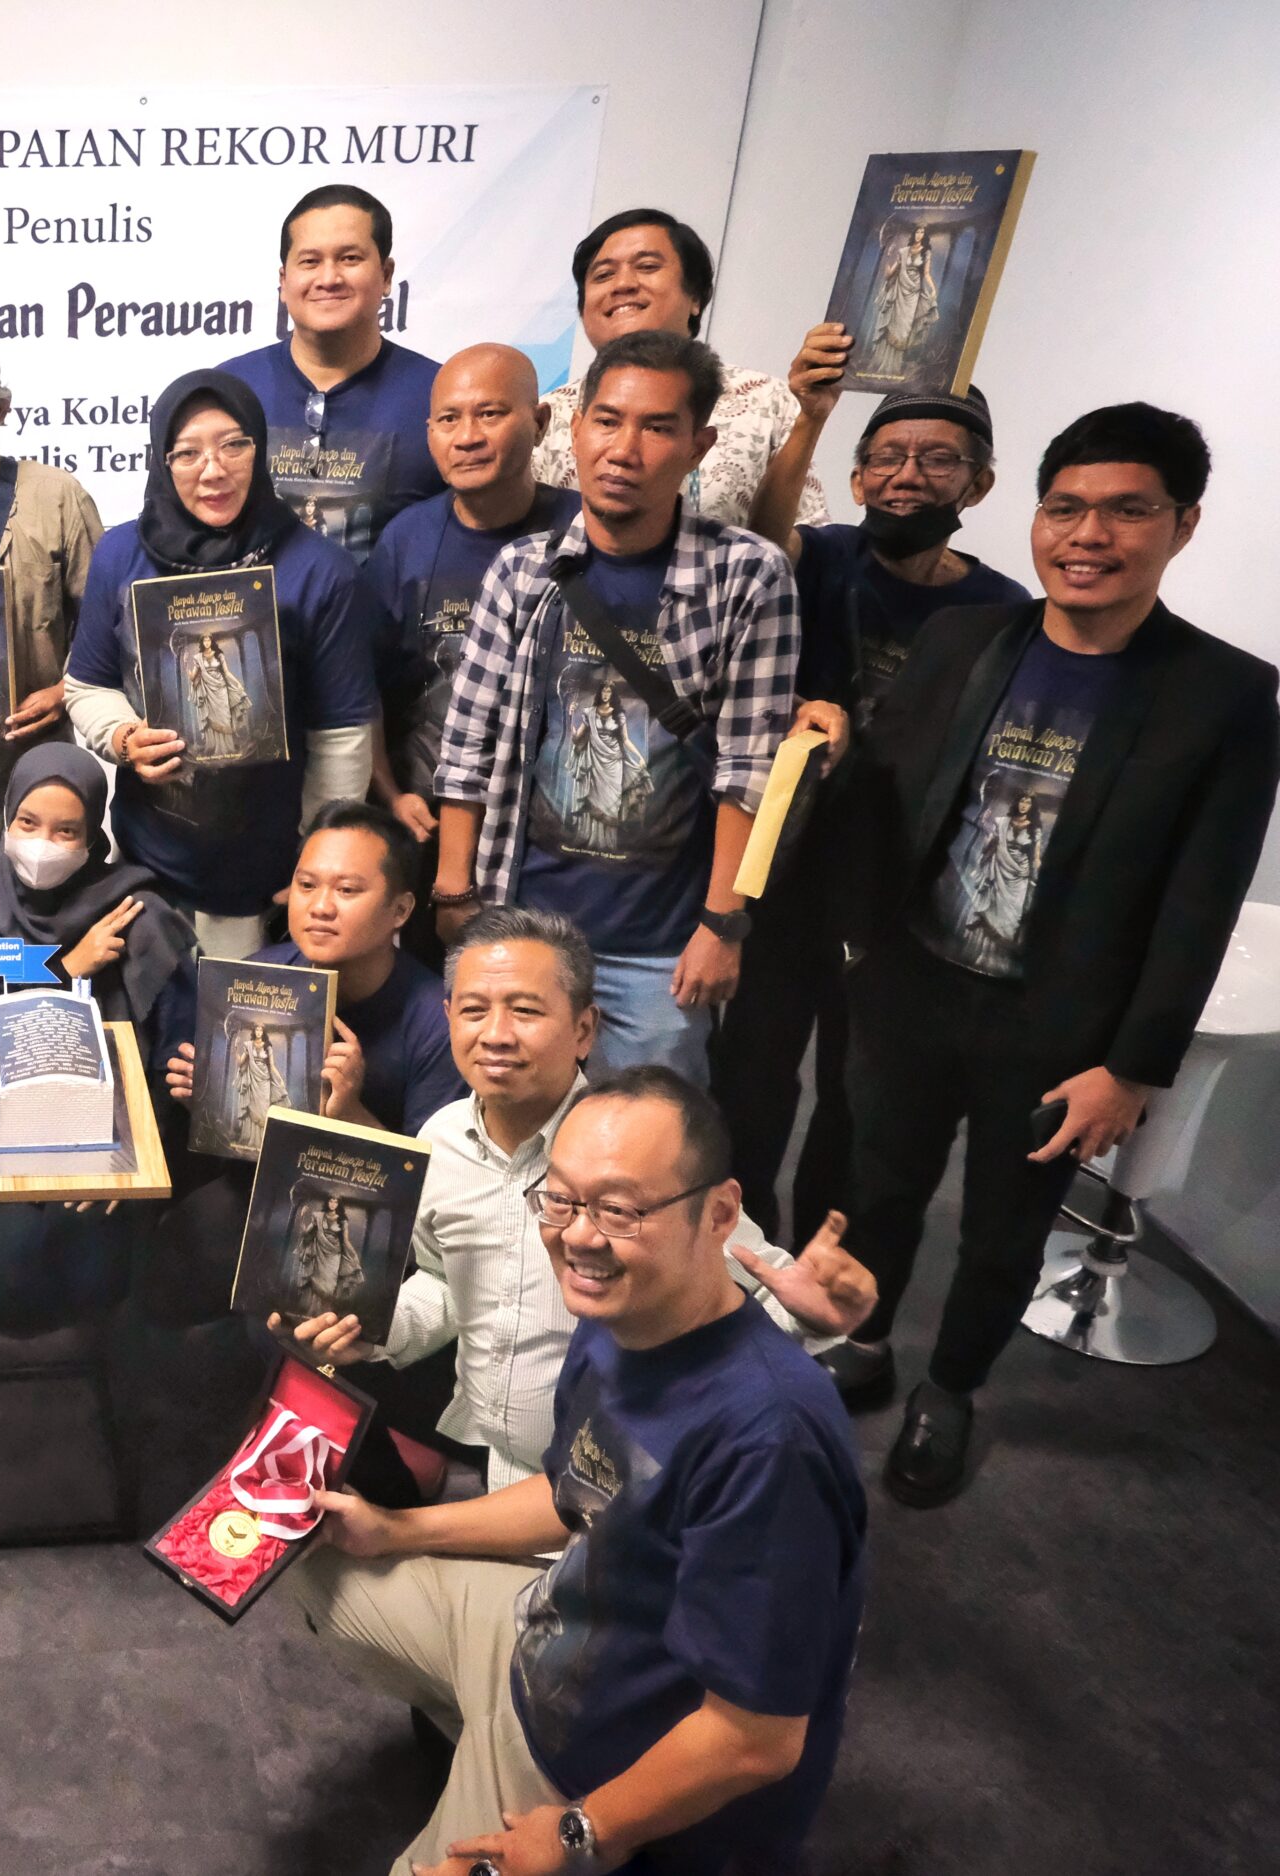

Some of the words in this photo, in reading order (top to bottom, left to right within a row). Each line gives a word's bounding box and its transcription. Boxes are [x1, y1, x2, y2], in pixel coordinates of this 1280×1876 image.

[160, 125, 331, 167] REKOR
[341, 124, 479, 164] MURI
[3, 203, 153, 244] Penulis
[67, 282, 252, 340] Perawan
[62, 395, 154, 425] Kolek
[988, 734, 1054, 767] Perawan
